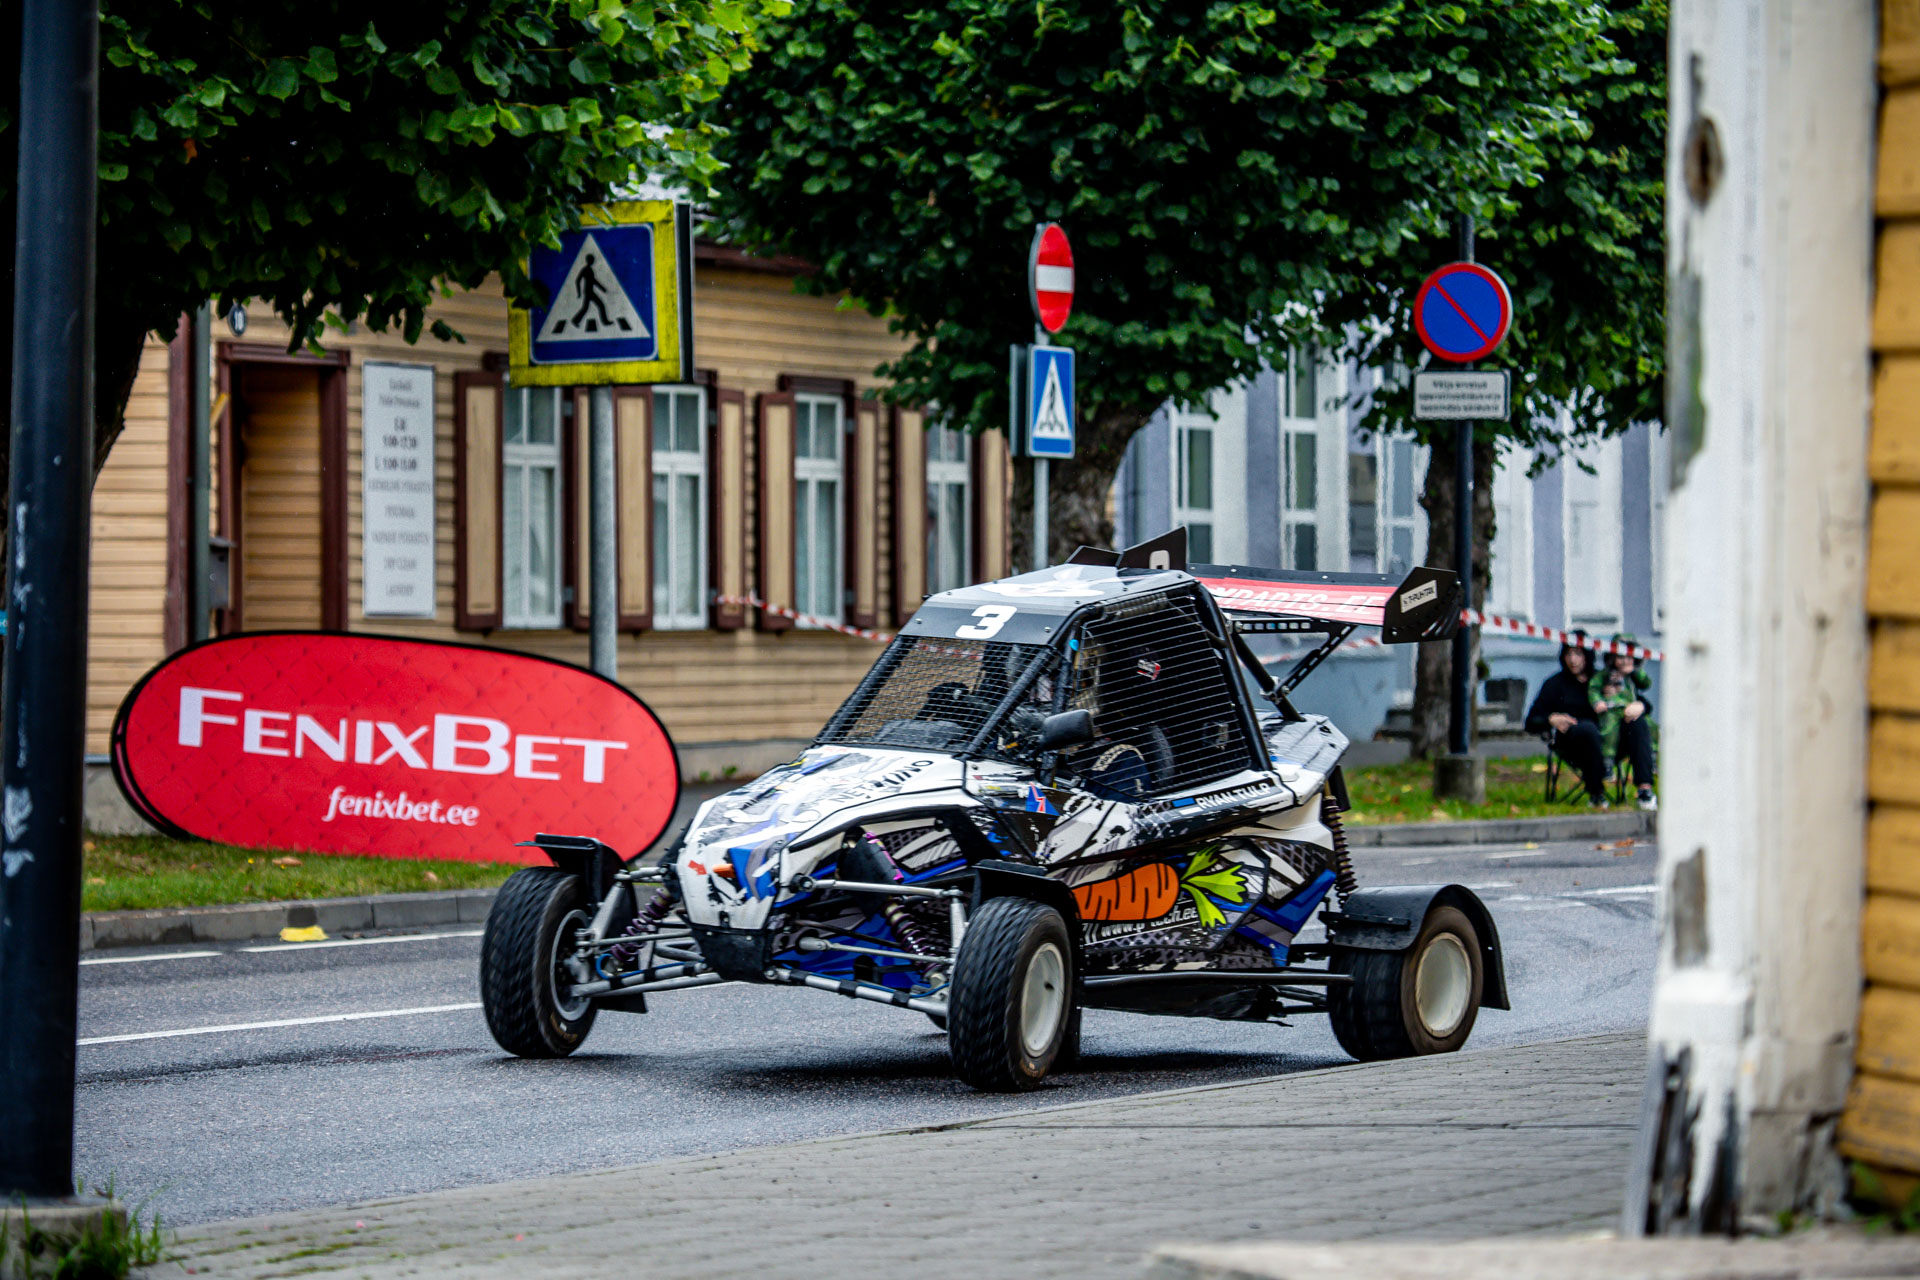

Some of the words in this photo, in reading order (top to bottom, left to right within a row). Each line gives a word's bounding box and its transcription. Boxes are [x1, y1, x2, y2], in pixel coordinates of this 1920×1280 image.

[955, 604, 1018, 640] 3
[322, 786, 480, 827] fenixbet.ee
[1195, 791, 1240, 809] RYAN
[1233, 783, 1272, 801] TULP
